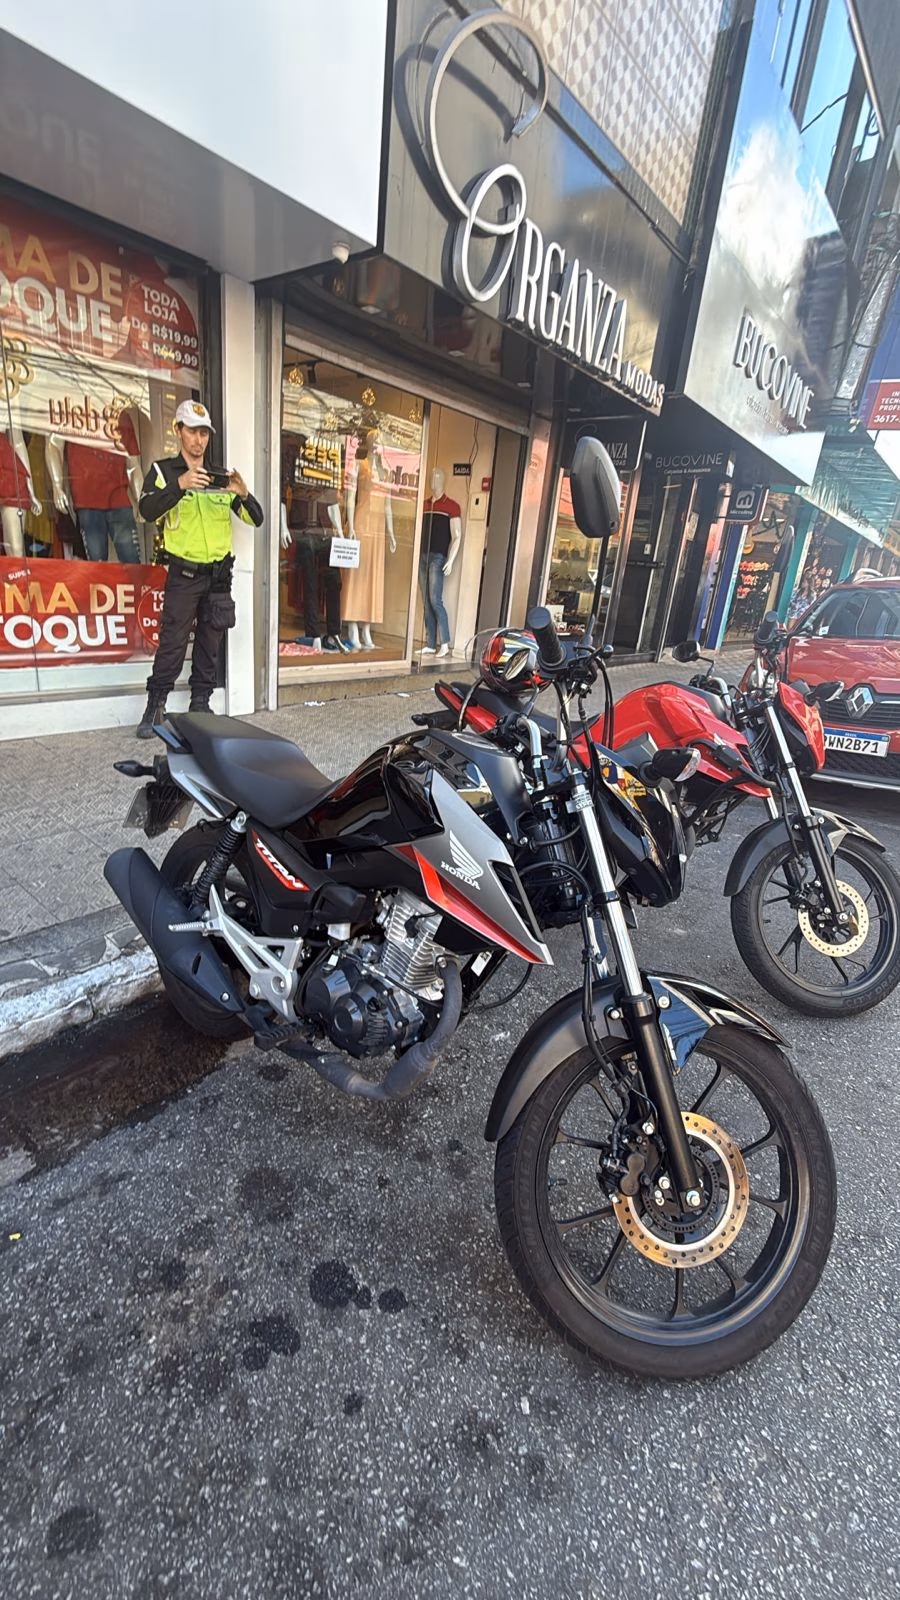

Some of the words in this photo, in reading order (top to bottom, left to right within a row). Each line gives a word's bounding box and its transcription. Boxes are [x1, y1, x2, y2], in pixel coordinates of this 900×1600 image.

[68, 250, 123, 307] DE
[142, 284, 180, 312] TODA
[144, 301, 179, 325] LOJA
[625, 361, 665, 408] MODAS
[733, 314, 815, 429] BUCOVINE
[873, 415, 900, 423] 3617-
[655, 453, 724, 469] BUCOVINE
[0, 582, 79, 614] MA
[89, 583, 135, 614] DE
[256, 838, 304, 888] TITAN
[440, 861, 481, 890] HONDA
[519, 1114, 541, 1246] MICHELIN
